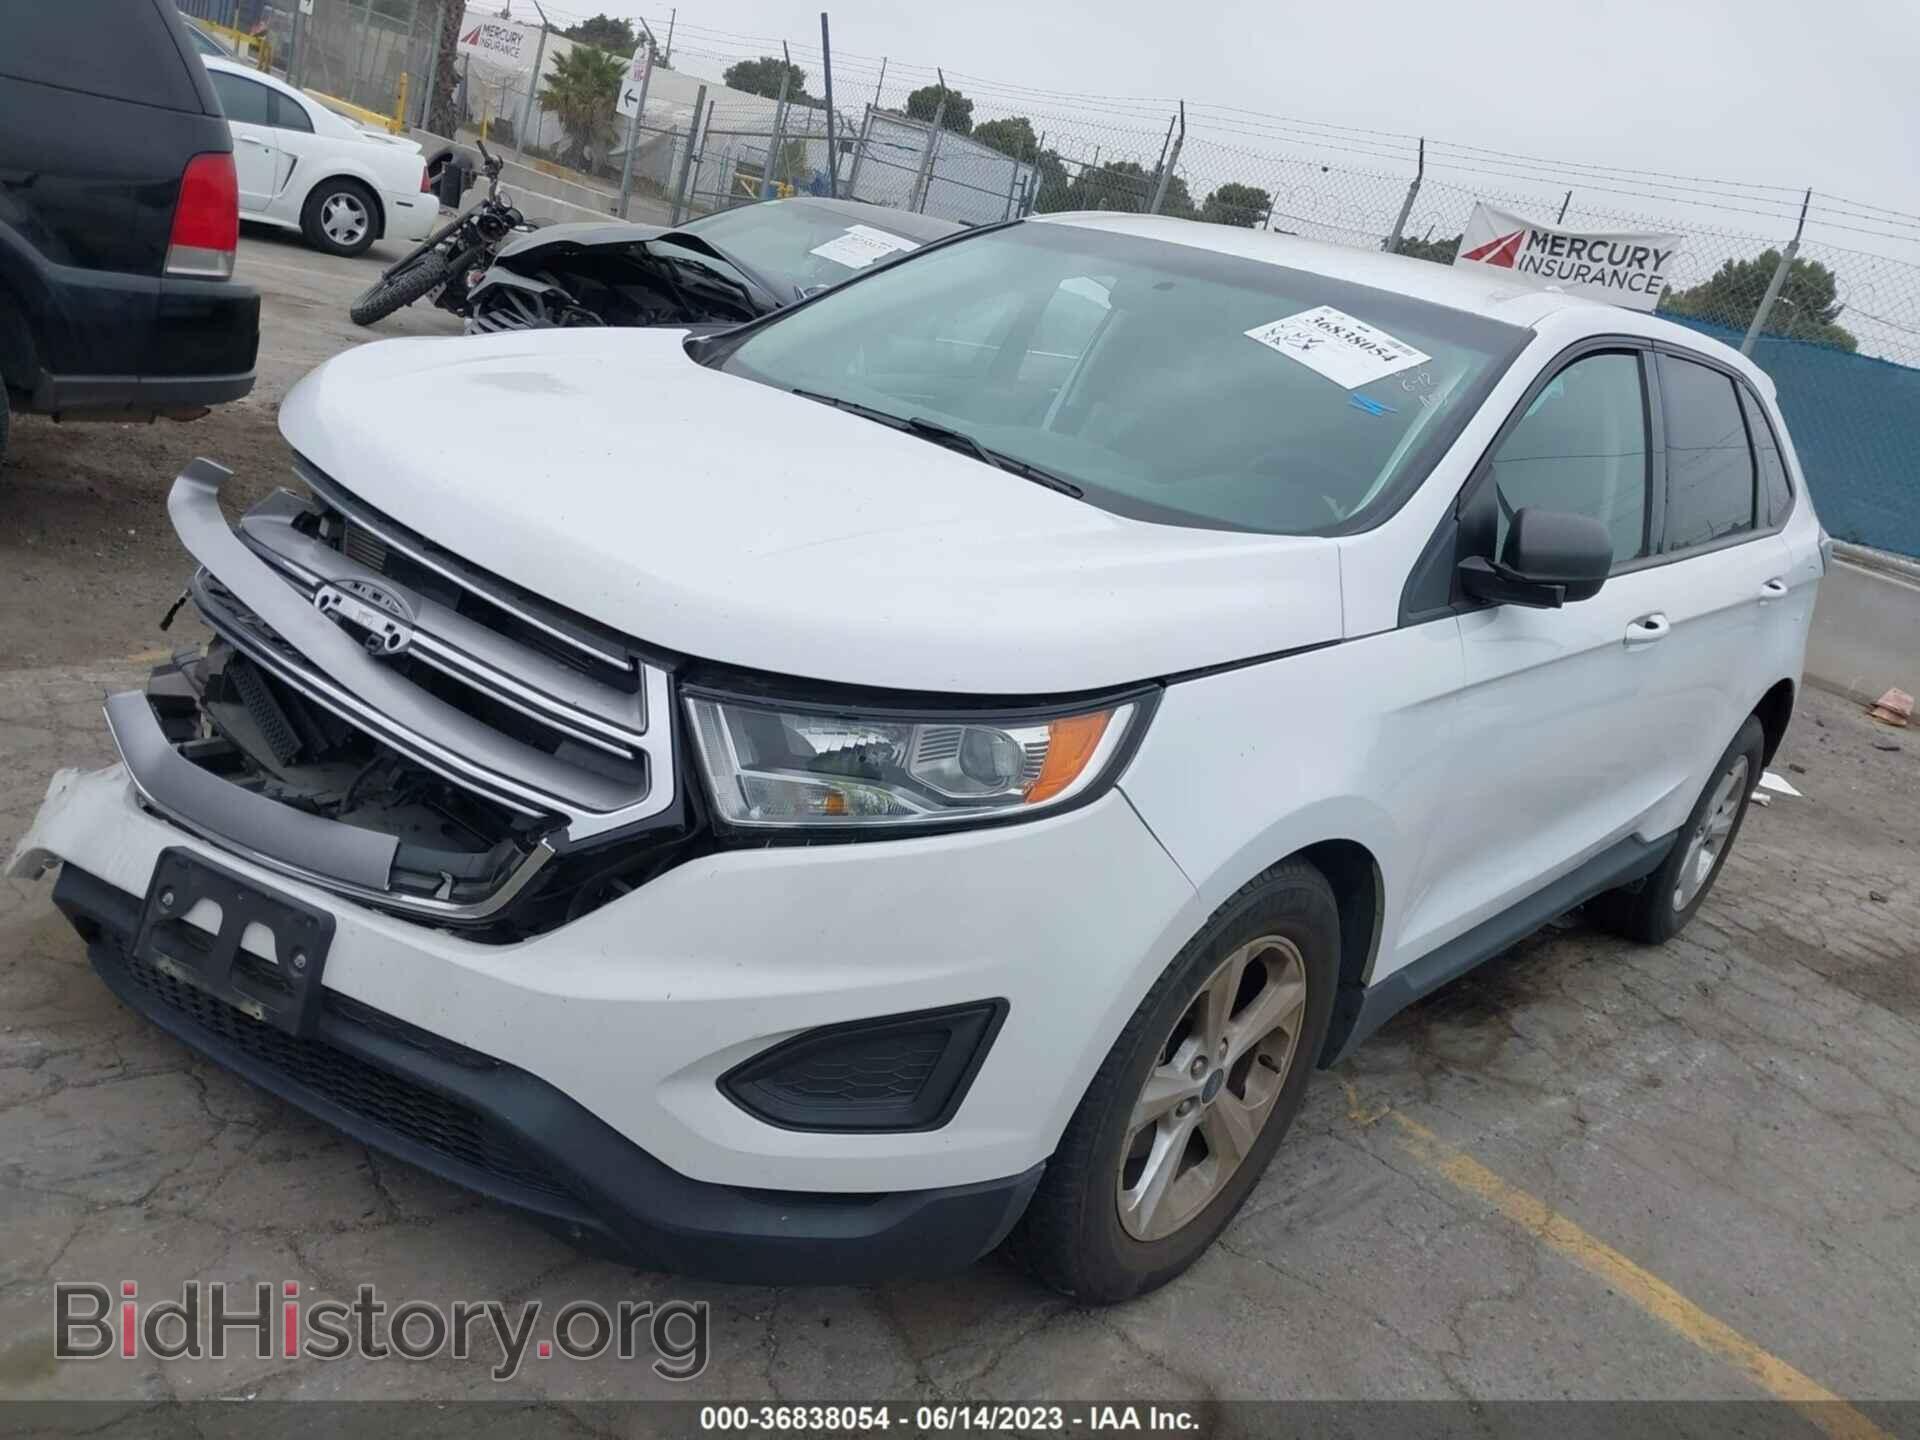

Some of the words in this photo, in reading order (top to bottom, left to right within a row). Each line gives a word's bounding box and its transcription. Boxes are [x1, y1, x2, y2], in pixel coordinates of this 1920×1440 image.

[480, 37, 521, 59] INSURANCE
[482, 24, 524, 46] MERCURY
[1526, 230, 1672, 273] MERCURY
[1518, 254, 1664, 295] INSURANCE
[1305, 316, 1399, 362] 36838054
